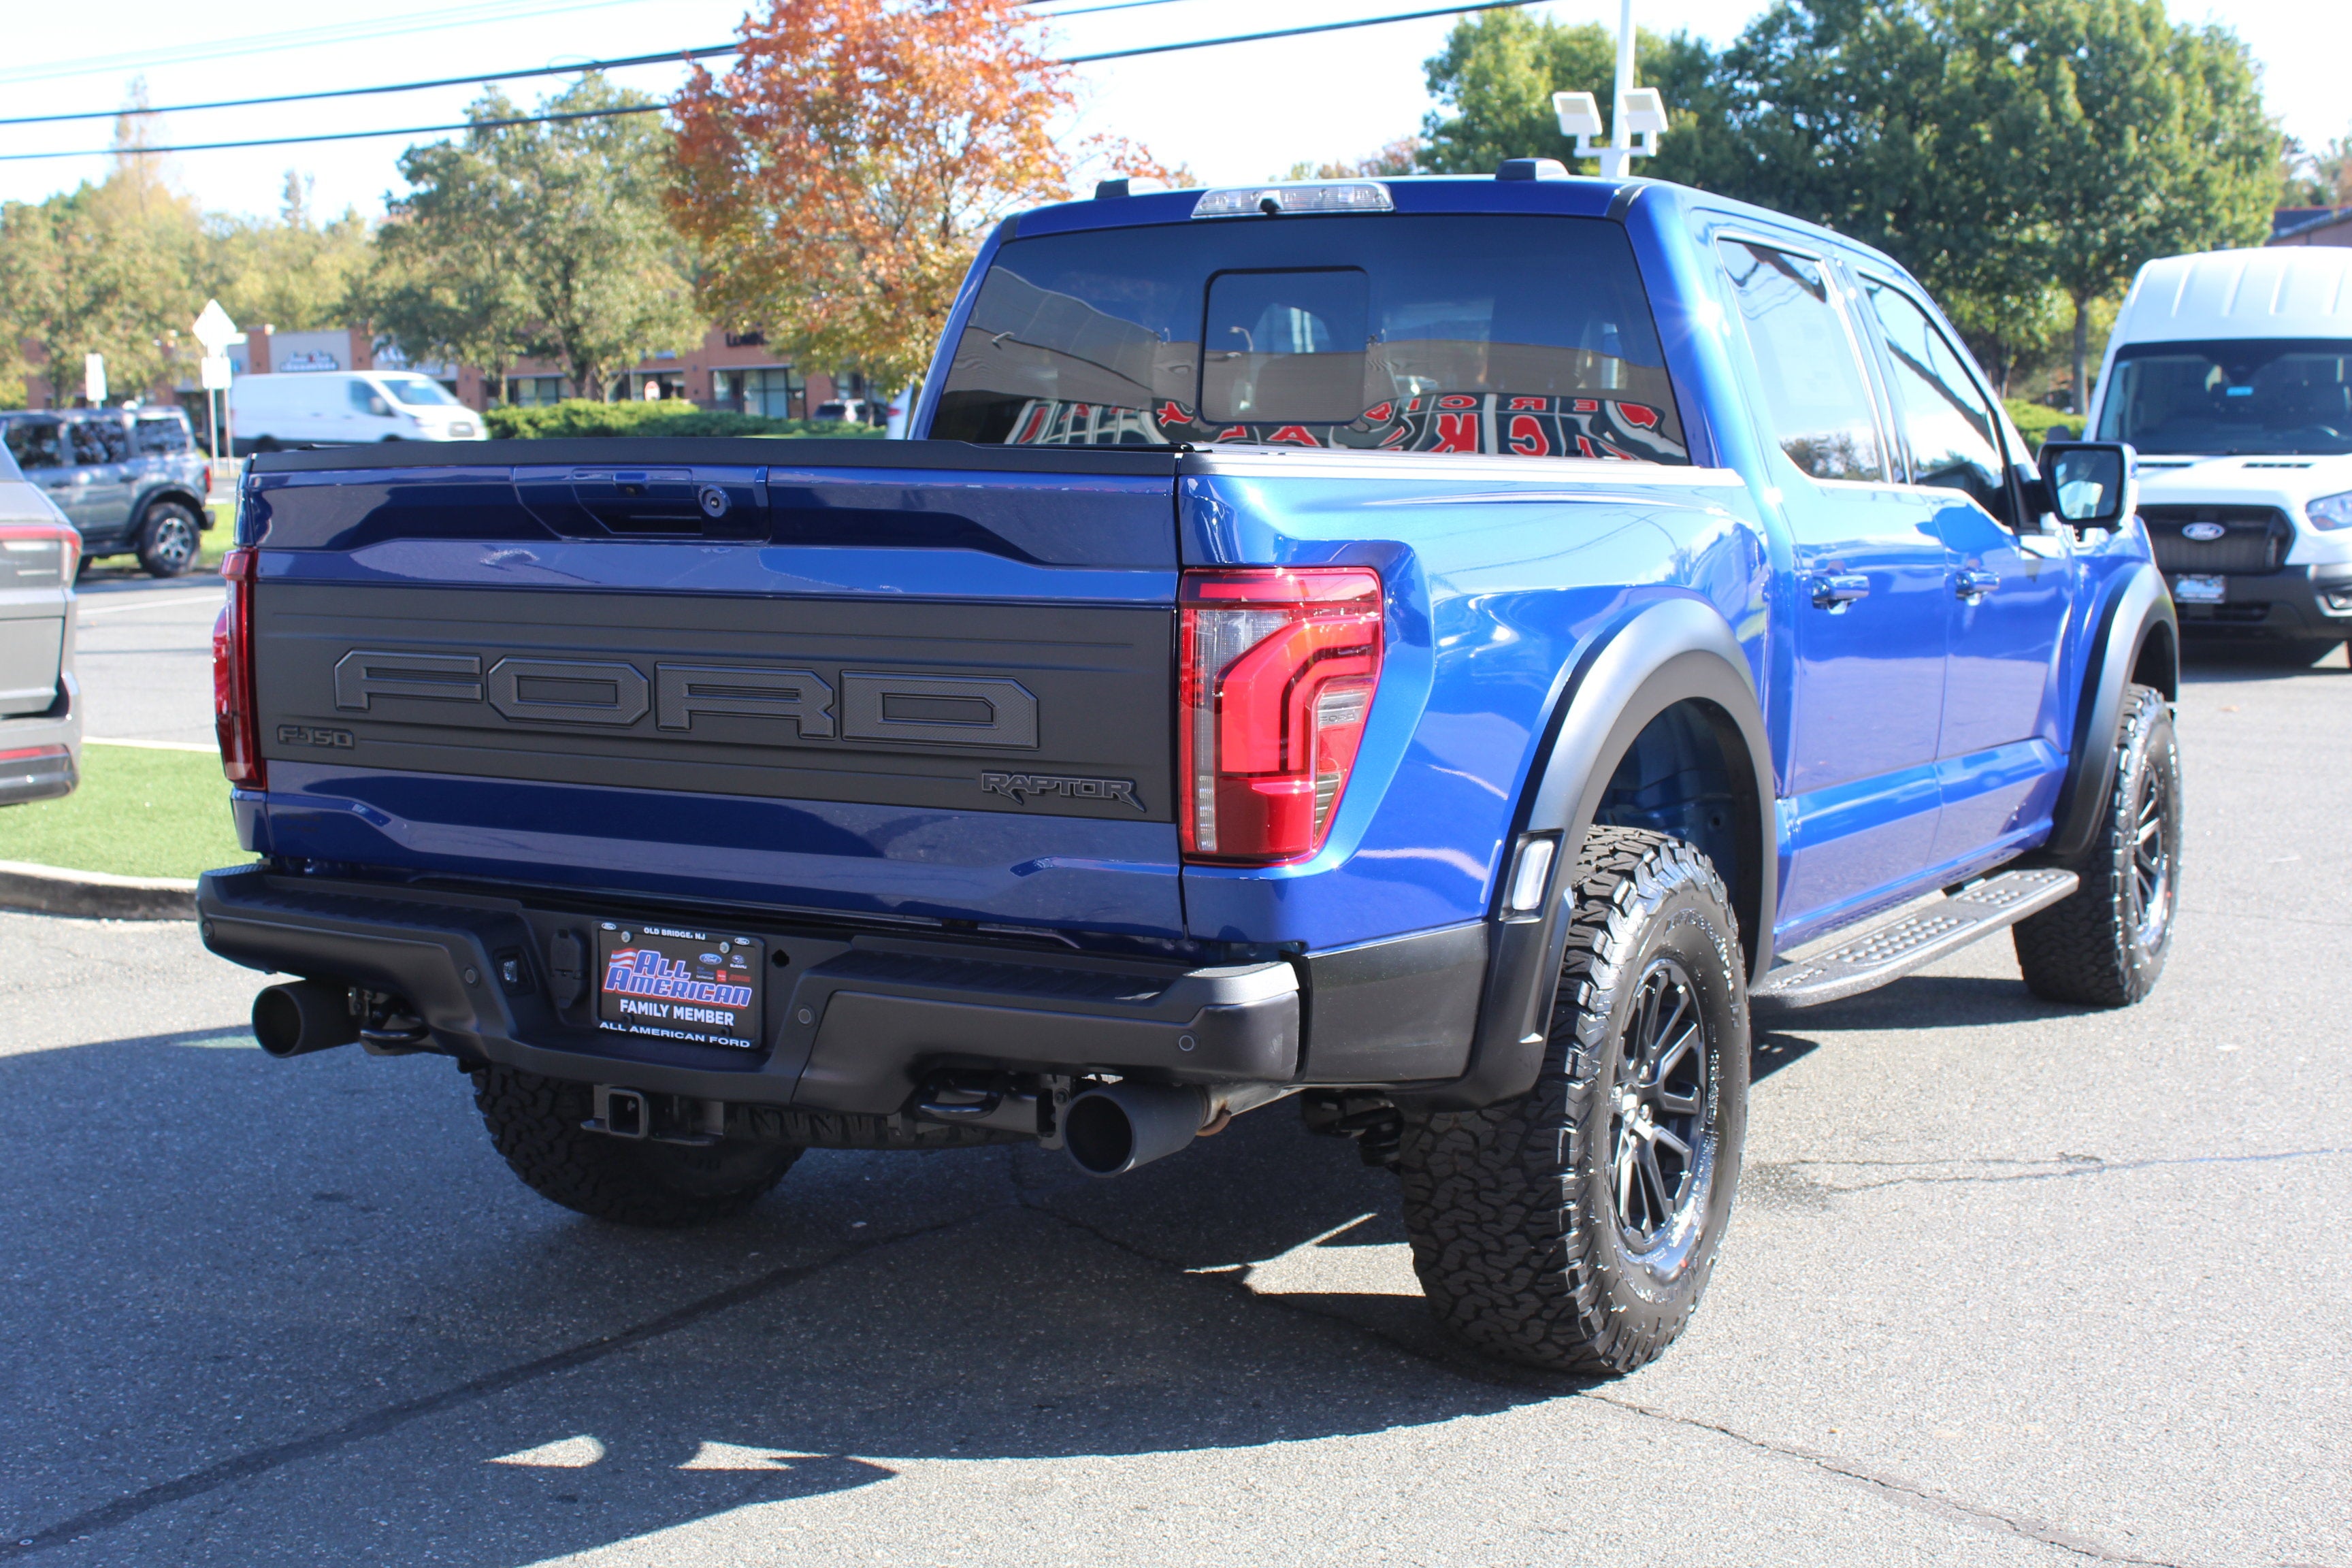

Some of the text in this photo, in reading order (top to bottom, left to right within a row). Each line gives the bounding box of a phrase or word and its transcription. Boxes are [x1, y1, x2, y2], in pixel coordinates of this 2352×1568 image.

[334, 649, 1040, 749] FORD
[277, 725, 355, 749] F-150
[981, 772, 1147, 813] RAPTOR
[643, 927, 659, 935] OLD
[661, 929, 693, 939] BRIDGE,
[619, 998, 734, 1026] FAMILY MEMBER
[599, 1022, 751, 1048] ALL AMERICAN FORD
